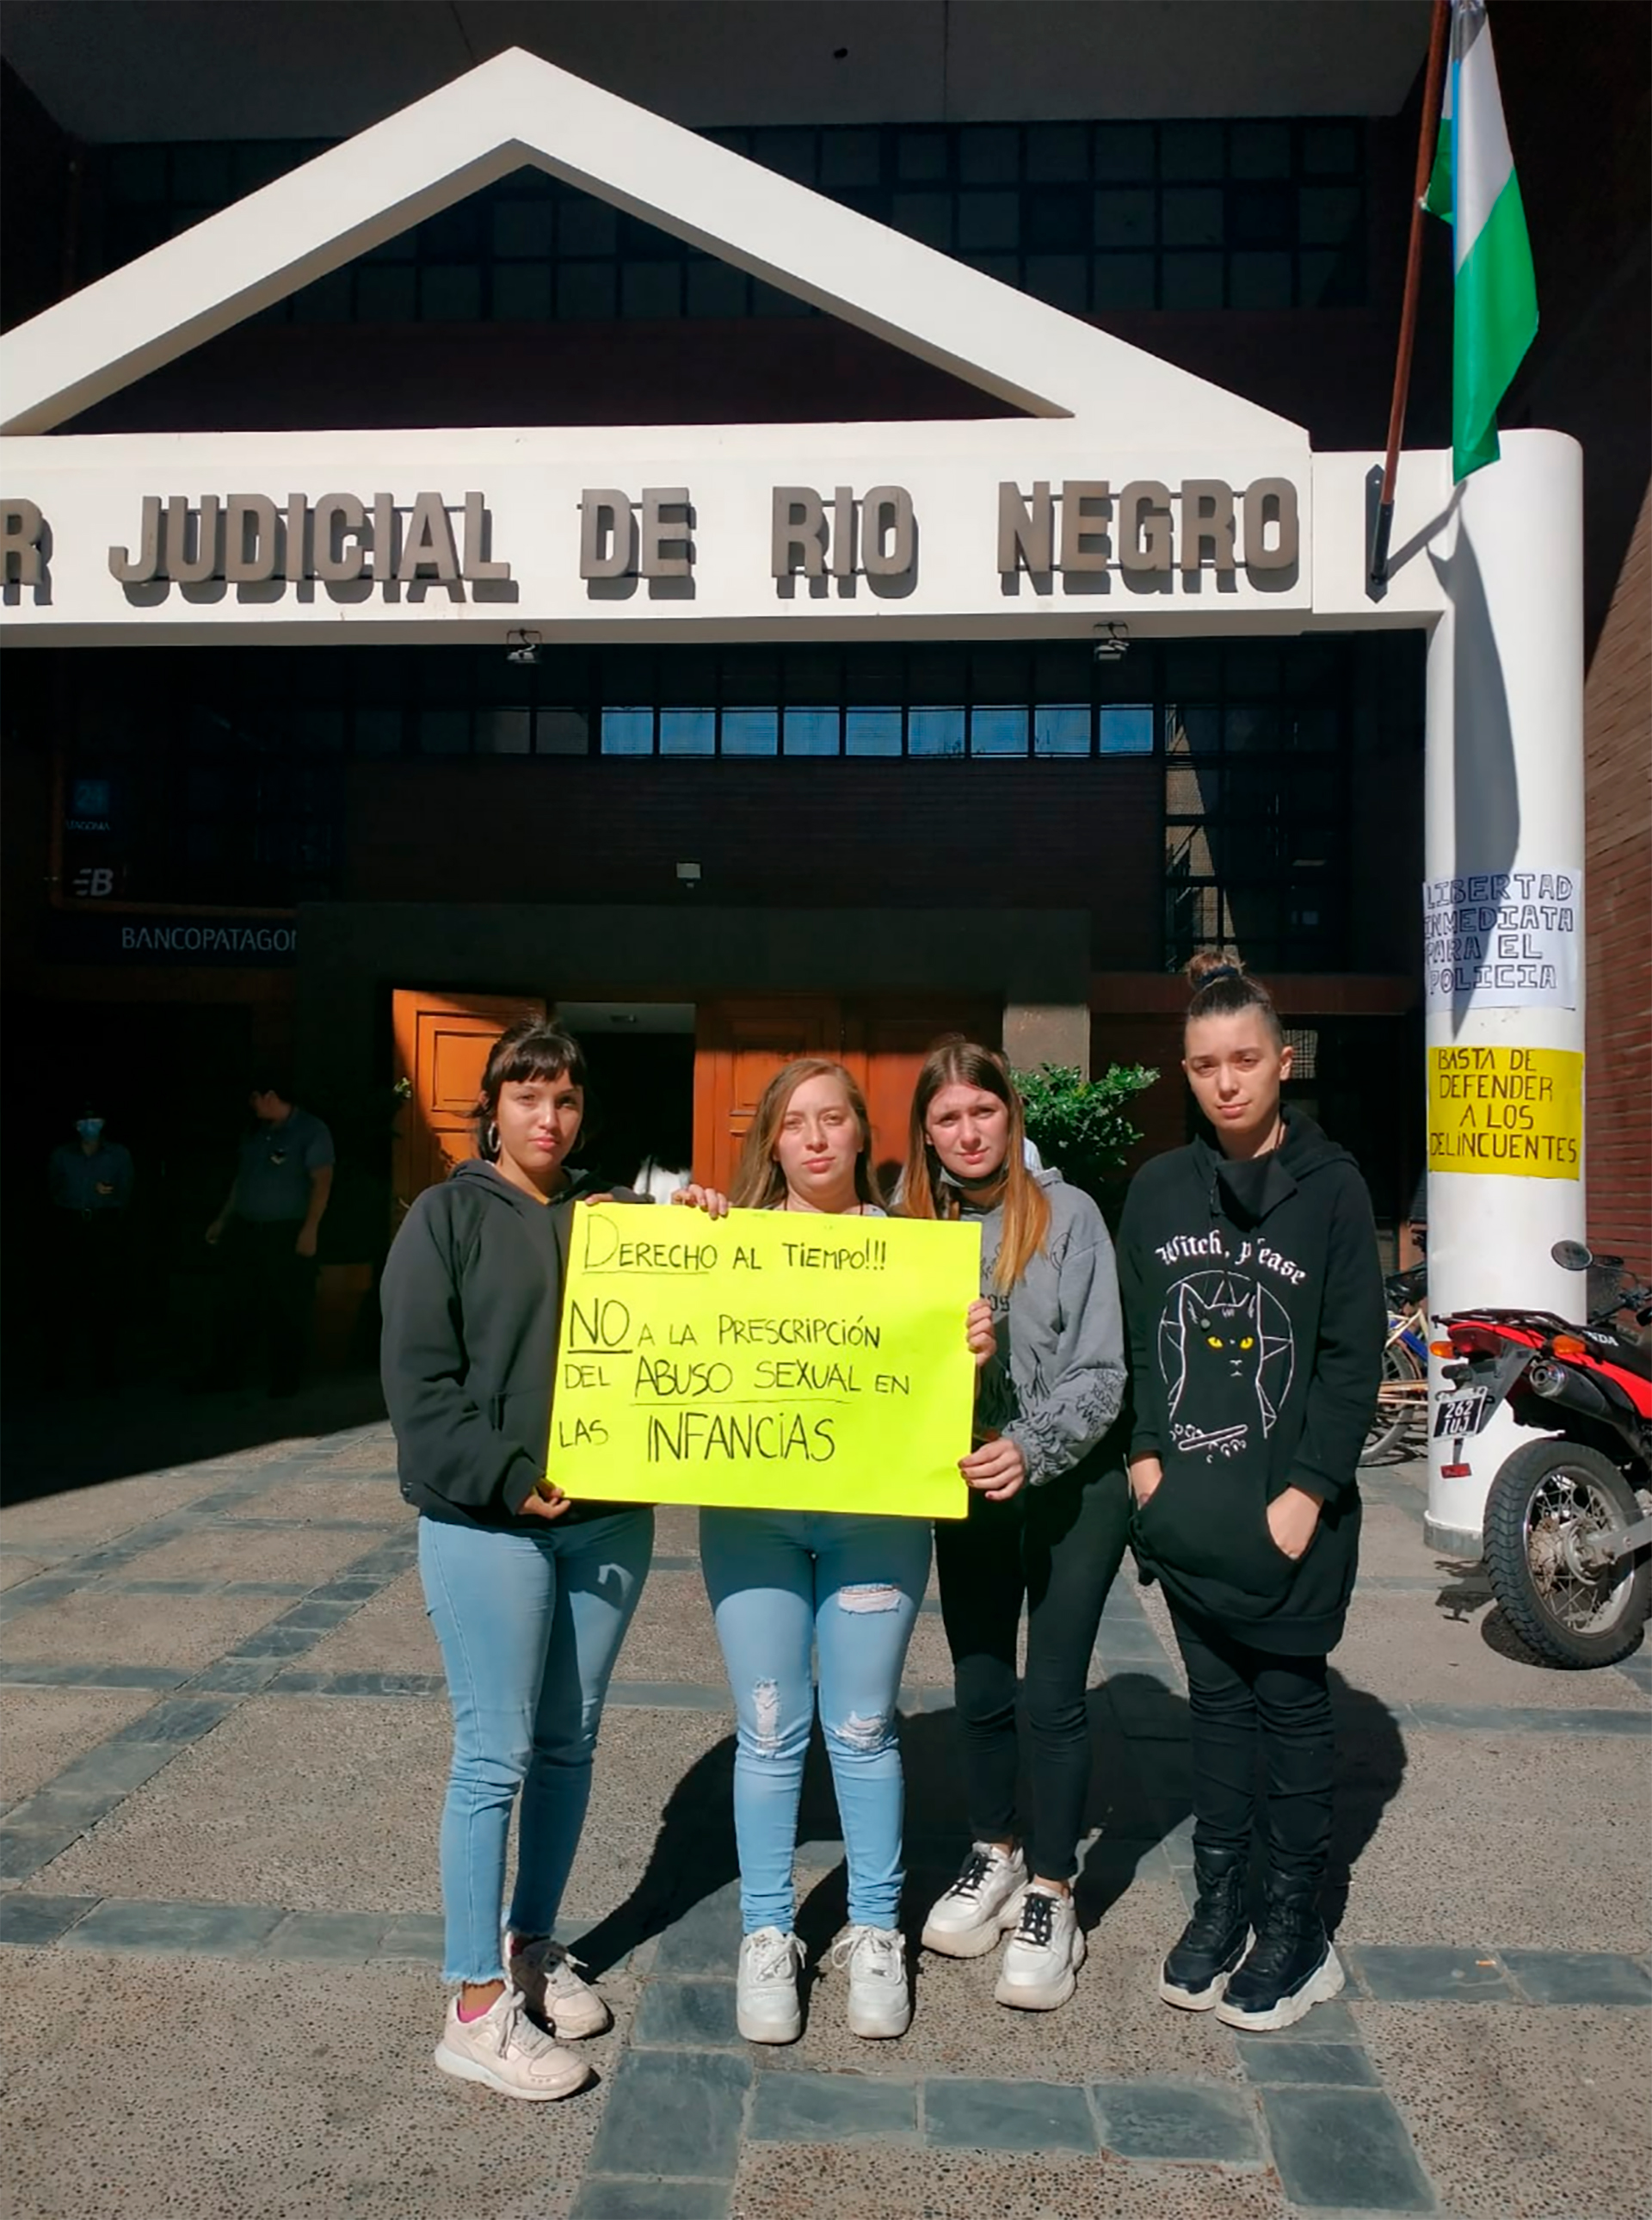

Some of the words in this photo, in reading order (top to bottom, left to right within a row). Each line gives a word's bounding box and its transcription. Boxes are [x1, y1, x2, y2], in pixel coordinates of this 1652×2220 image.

[108, 491, 511, 583] JUDICIAL
[580, 487, 690, 579] DE
[772, 485, 913, 577] RIO
[998, 477, 1298, 572] NEGRO
[1427, 873, 1574, 910] LIBERTAD
[1424, 904, 1574, 939] INMEDIATA
[1497, 934, 1543, 959] EL
[1430, 965, 1557, 995] POLICIA
[1438, 1048, 1495, 1070] BASTA
[1510, 1049, 1537, 1071] DE
[1439, 1074, 1553, 1101] DEFENDER
[1459, 1104, 1476, 1127] A
[1486, 1104, 1534, 1130] LOS
[583, 1213, 718, 1269] DERECHO
[732, 1245, 762, 1270] AL
[1155, 1230, 1230, 1266] Witch,
[1234, 1237, 1307, 1286] pease
[569, 1298, 631, 1347] NO
[638, 1323, 655, 1347] A
[669, 1323, 696, 1346] LA
[564, 1363, 611, 1389] DEL
[634, 1355, 734, 1398] ABUSO
[754, 1360, 861, 1391] SEXUAL
[875, 1375, 909, 1395] EN
[1444, 1400, 1474, 1419] 262
[558, 1418, 609, 1448] LAS
[1440, 1415, 1470, 1435] IUJ
